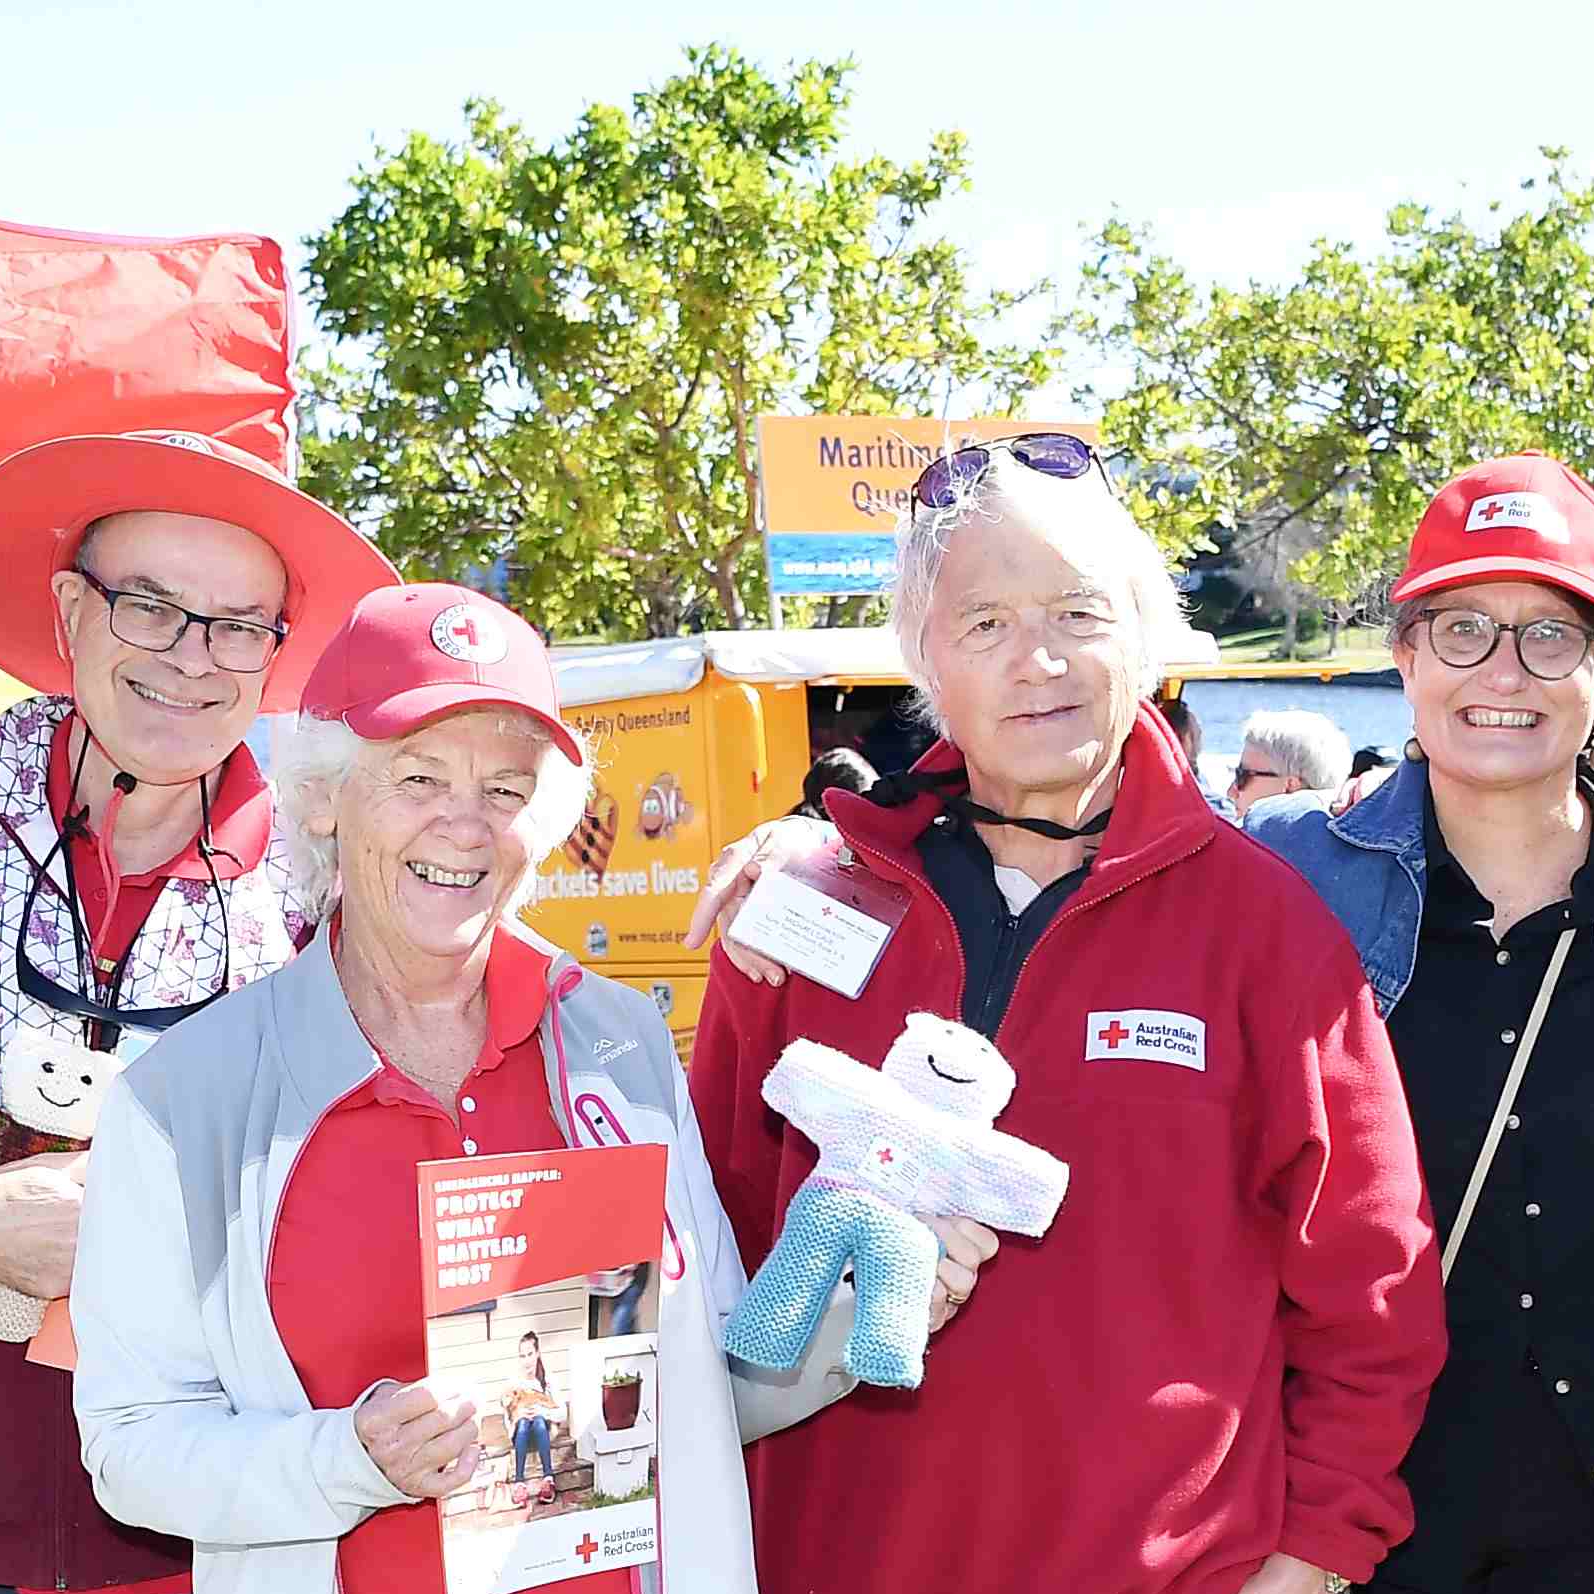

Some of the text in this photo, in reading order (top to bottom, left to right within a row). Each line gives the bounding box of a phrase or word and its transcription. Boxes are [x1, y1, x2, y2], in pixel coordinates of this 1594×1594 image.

[616, 704, 691, 733] Queensland
[526, 861, 700, 901] ackets save lives
[1135, 1022, 1198, 1043] Australian
[1135, 1035, 1197, 1056] Red Cross
[435, 1188, 524, 1218] PROTECT
[436, 1215, 497, 1241] WHAT
[437, 1234, 528, 1265] MATTERS
[438, 1262, 492, 1289] MOST
[603, 1526, 655, 1543] Australian
[603, 1539, 655, 1557] Red Cross
